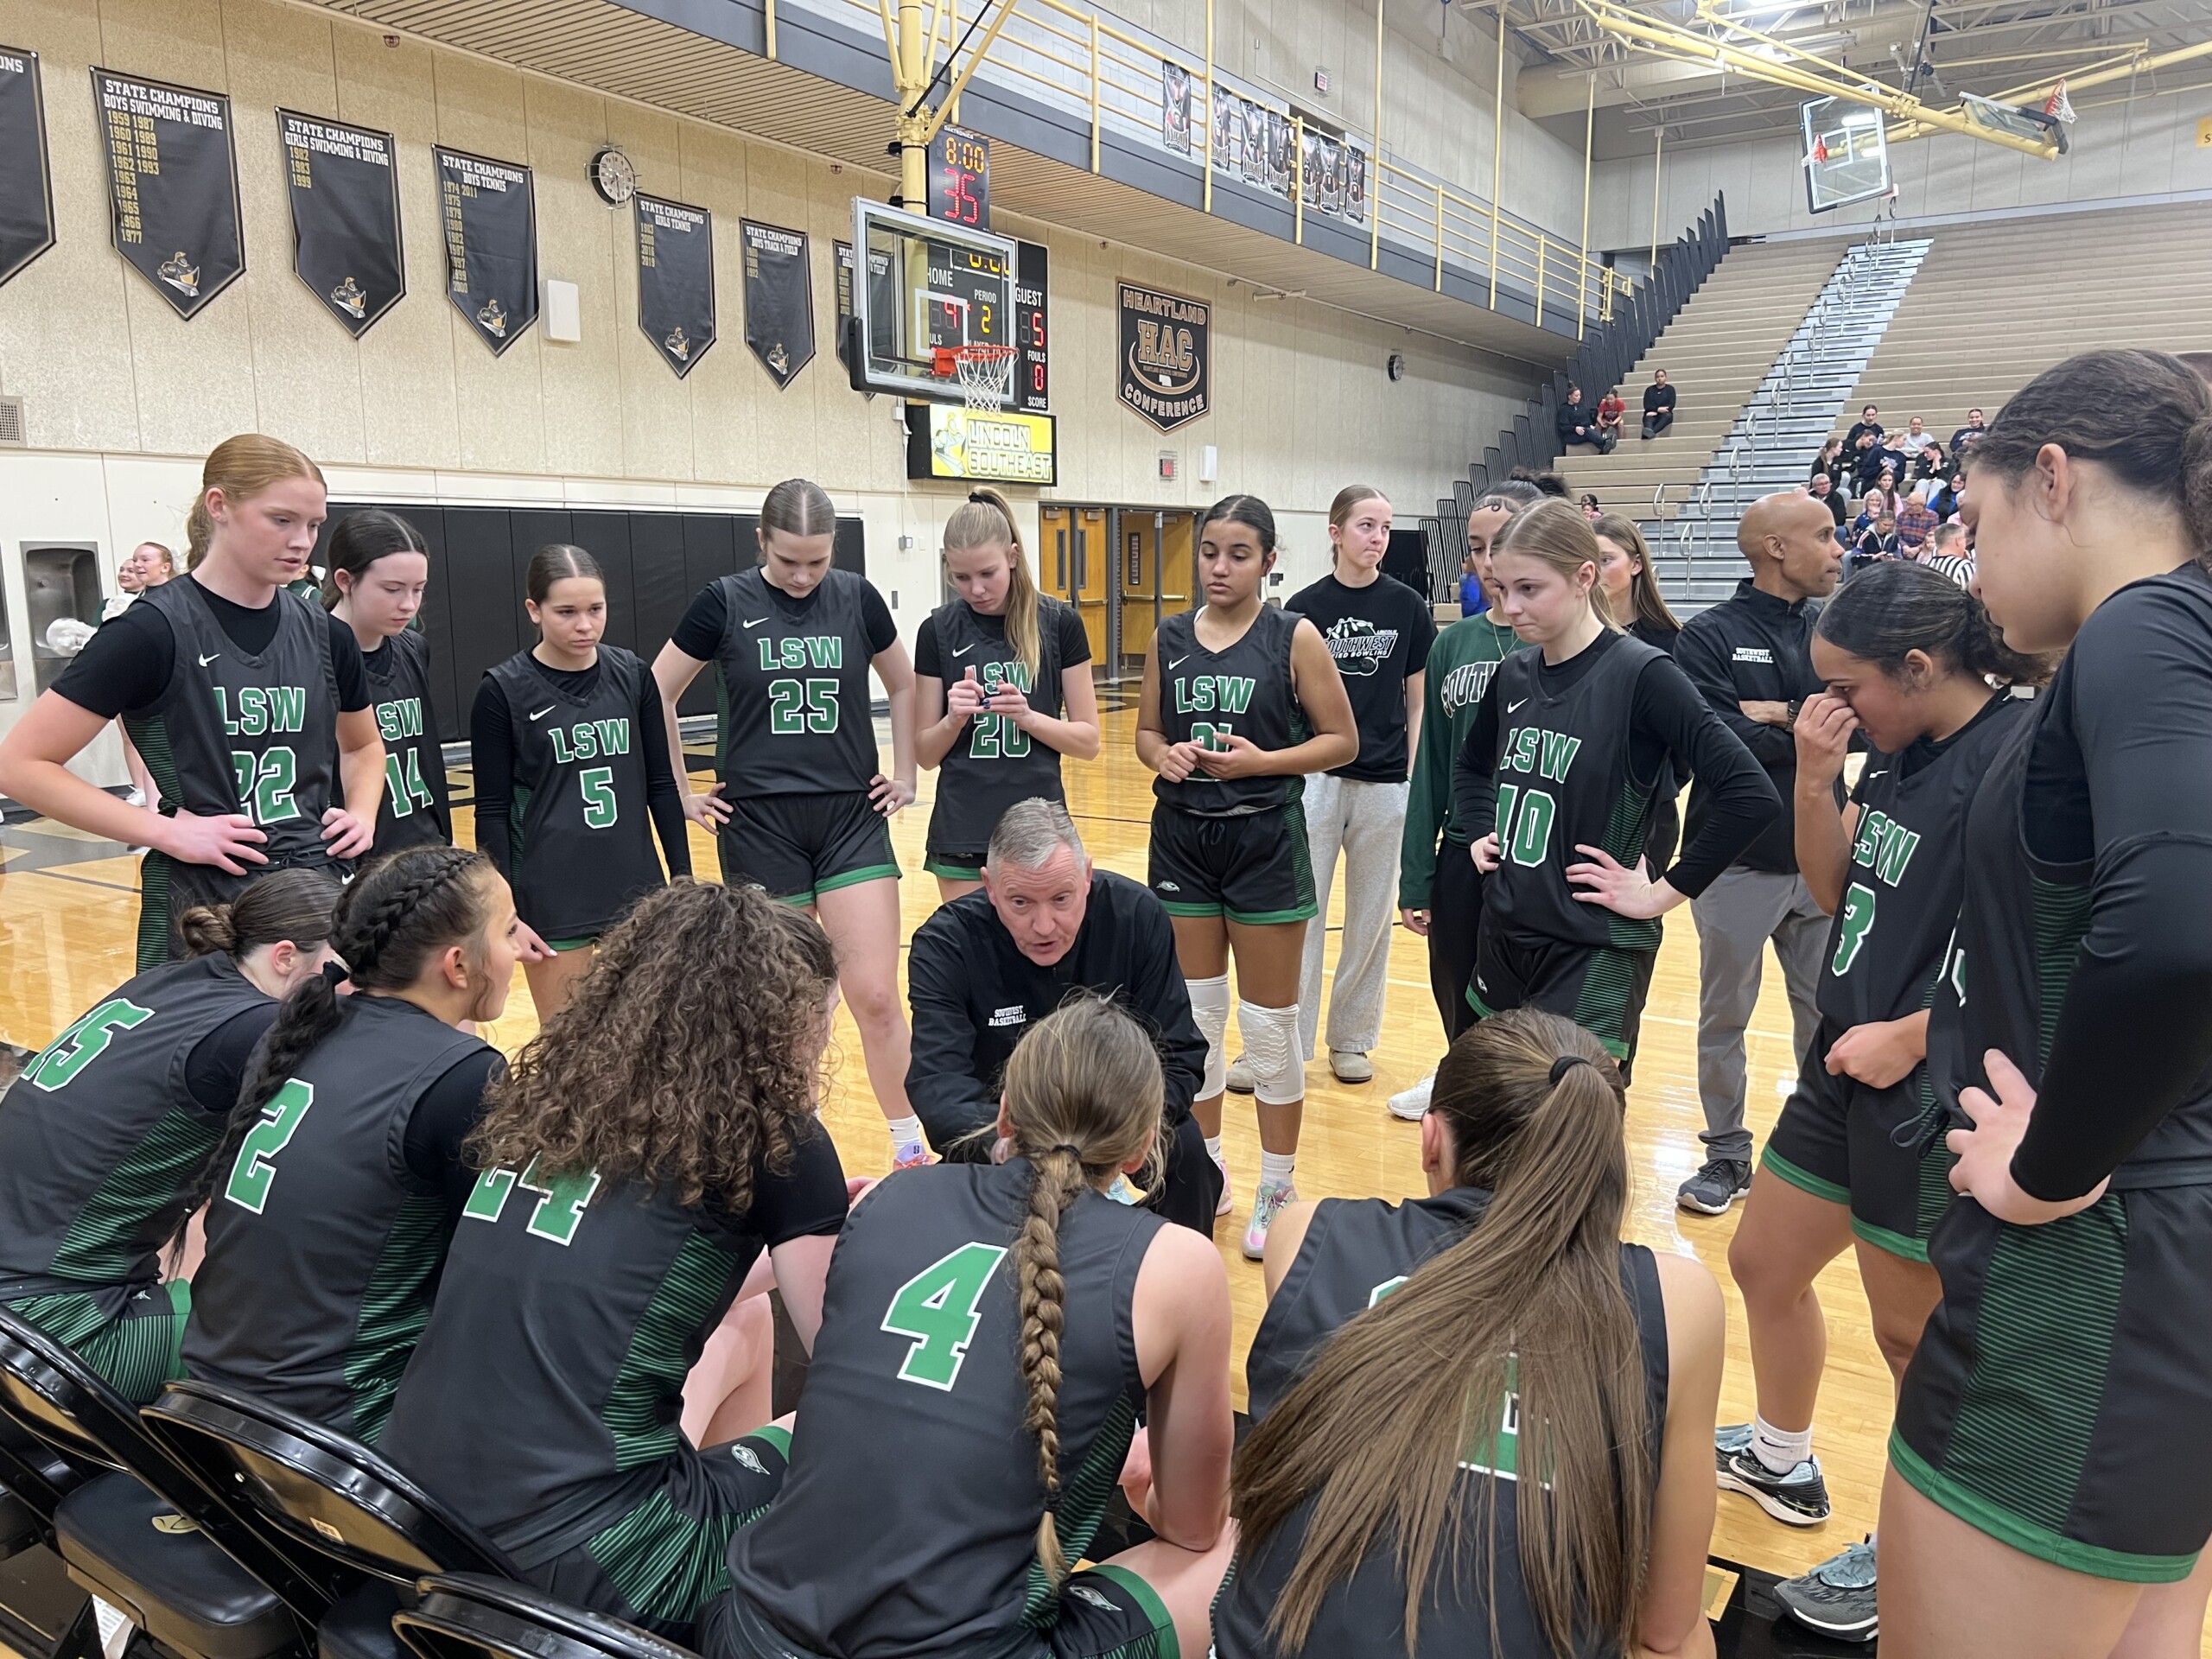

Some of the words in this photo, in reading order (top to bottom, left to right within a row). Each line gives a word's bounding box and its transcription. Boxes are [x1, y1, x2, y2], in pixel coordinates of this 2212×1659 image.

[104, 93, 128, 111] BOYS
[130, 99, 181, 122] SWIMMING
[183, 111, 190, 122] &
[192, 112, 223, 130] DIVING
[105, 79, 147, 100] STATE
[149, 88, 219, 114] CHAMPIONS
[107, 110, 130, 126] 1959
[133, 115, 155, 130] 1987
[109, 125, 131, 141] 1960
[134, 130, 156, 146] 1989
[288, 119, 323, 138] STATE
[326, 128, 384, 151] CHAMPIONS
[111, 140, 132, 156] 1961
[136, 145, 158, 161] 1990
[112, 155, 135, 171] 1962
[137, 160, 159, 175] 1993
[285, 131, 308, 149] GIRLS
[310, 137, 353, 160] SWIMMING
[356, 149, 361, 160] &
[363, 149, 389, 167] DIVING
[289, 146, 309, 161] 1982
[945, 137, 985, 174] 8:00
[114, 170, 137, 186] 1963
[292, 174, 312, 188] 1999
[442, 155, 473, 172] STATE
[474, 162, 524, 184] CHAMPIONS
[463, 172, 480, 187] BOYS
[481, 175, 506, 193] TENNIS
[116, 185, 137, 200] 1964
[443, 181, 460, 194] 1974
[461, 184, 478, 198] 2011
[444, 193, 461, 207] 1975
[944, 168, 978, 224] 35
[118, 200, 139, 215] 1965
[120, 214, 141, 230] 1966
[641, 200, 664, 215] STATE
[665, 206, 704, 225] CHAMPIONS
[655, 214, 671, 227] GIRLS
[671, 218, 691, 232] TENNIS
[121, 228, 143, 245] 1977
[746, 226, 766, 239] STATE
[767, 231, 802, 247] CHAMPIONS
[764, 239, 780, 252] TRACK
[784, 245, 798, 257] FIELD
[928, 267, 953, 287] HOME
[974, 289, 997, 303] PERIOD
[1014, 286, 1043, 308] GUEST
[1123, 289, 1206, 326] HEARTLAND
[982, 304, 991, 334] 2
[1033, 312, 1045, 347] 5
[1027, 350, 1046, 363] FOULS
[1138, 319, 1193, 372] HAC
[1027, 397, 1046, 409] SCORE
[1124, 383, 1205, 417] CONFERENCE
[967, 417, 1031, 451] LINCOLN
[967, 447, 1052, 480] SOUTHEAST
[758, 636, 842, 671] LSW
[1325, 636, 1395, 654] OUTHWEST
[213, 686, 305, 735] LSW
[768, 678, 840, 734] 25
[1174, 676, 1256, 714] LSW
[378, 697, 423, 741] SW
[969, 711, 1031, 759] 20
[548, 717, 630, 764] LSW
[1499, 727, 1581, 785] LSW
[232, 747, 302, 825] 22
[385, 747, 433, 818] 14
[580, 766, 618, 830] 5
[1496, 783, 1555, 868] 10
[1832, 881, 1875, 976] 3
[988, 1014, 1026, 1026] BASKETBALL
[21, 998, 156, 1092] 15
[225, 1077, 314, 1215] 2
[880, 1242, 1008, 1391] 4
